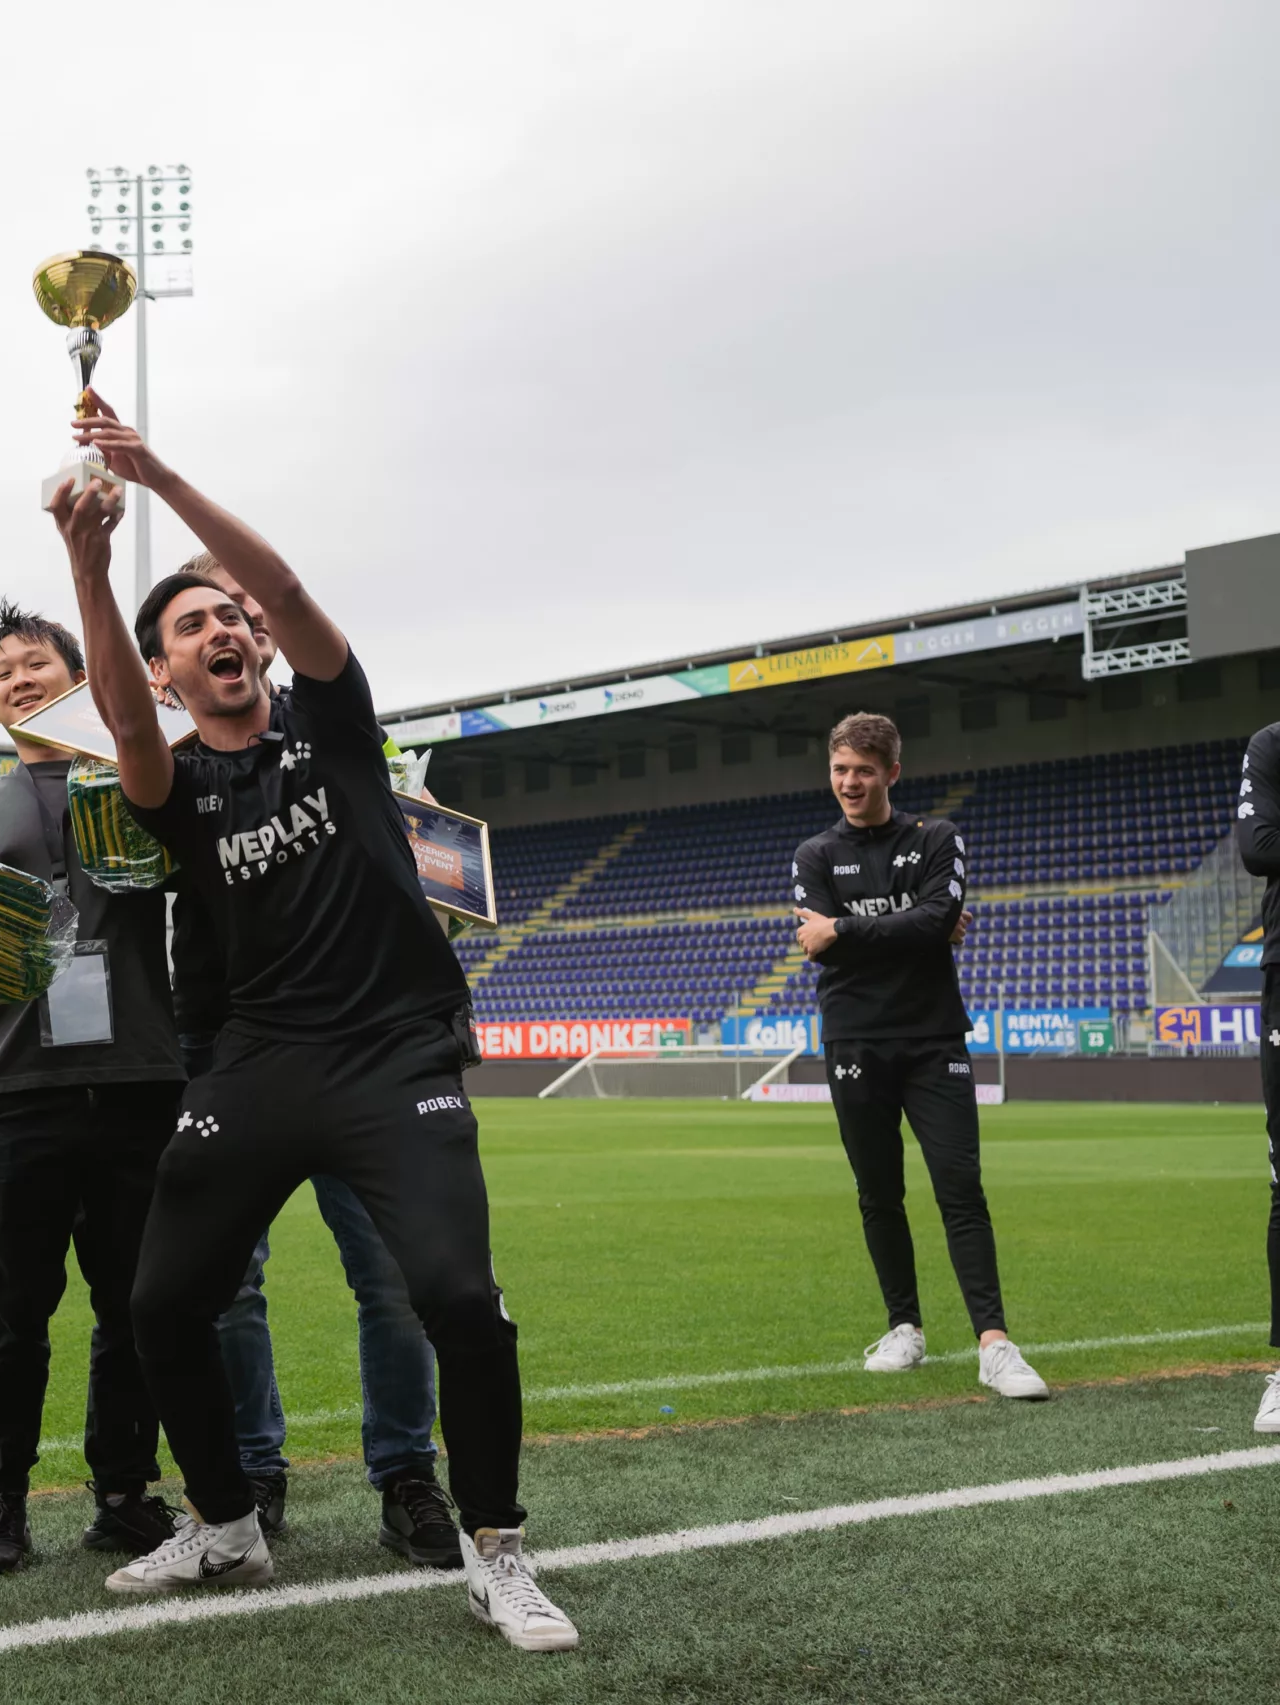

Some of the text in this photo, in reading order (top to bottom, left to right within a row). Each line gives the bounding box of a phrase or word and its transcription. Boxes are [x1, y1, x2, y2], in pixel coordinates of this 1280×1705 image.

[224, 821, 337, 886] ESPORTS
[414, 843, 454, 862] AZERION
[424, 856, 454, 872] EVENT
[833, 864, 861, 875] ROBEY
[1008, 1015, 1073, 1031] RENTAL
[744, 1019, 808, 1048] Collé
[1008, 1030, 1075, 1047] & SALES
[417, 1096, 464, 1115] ROBEY
